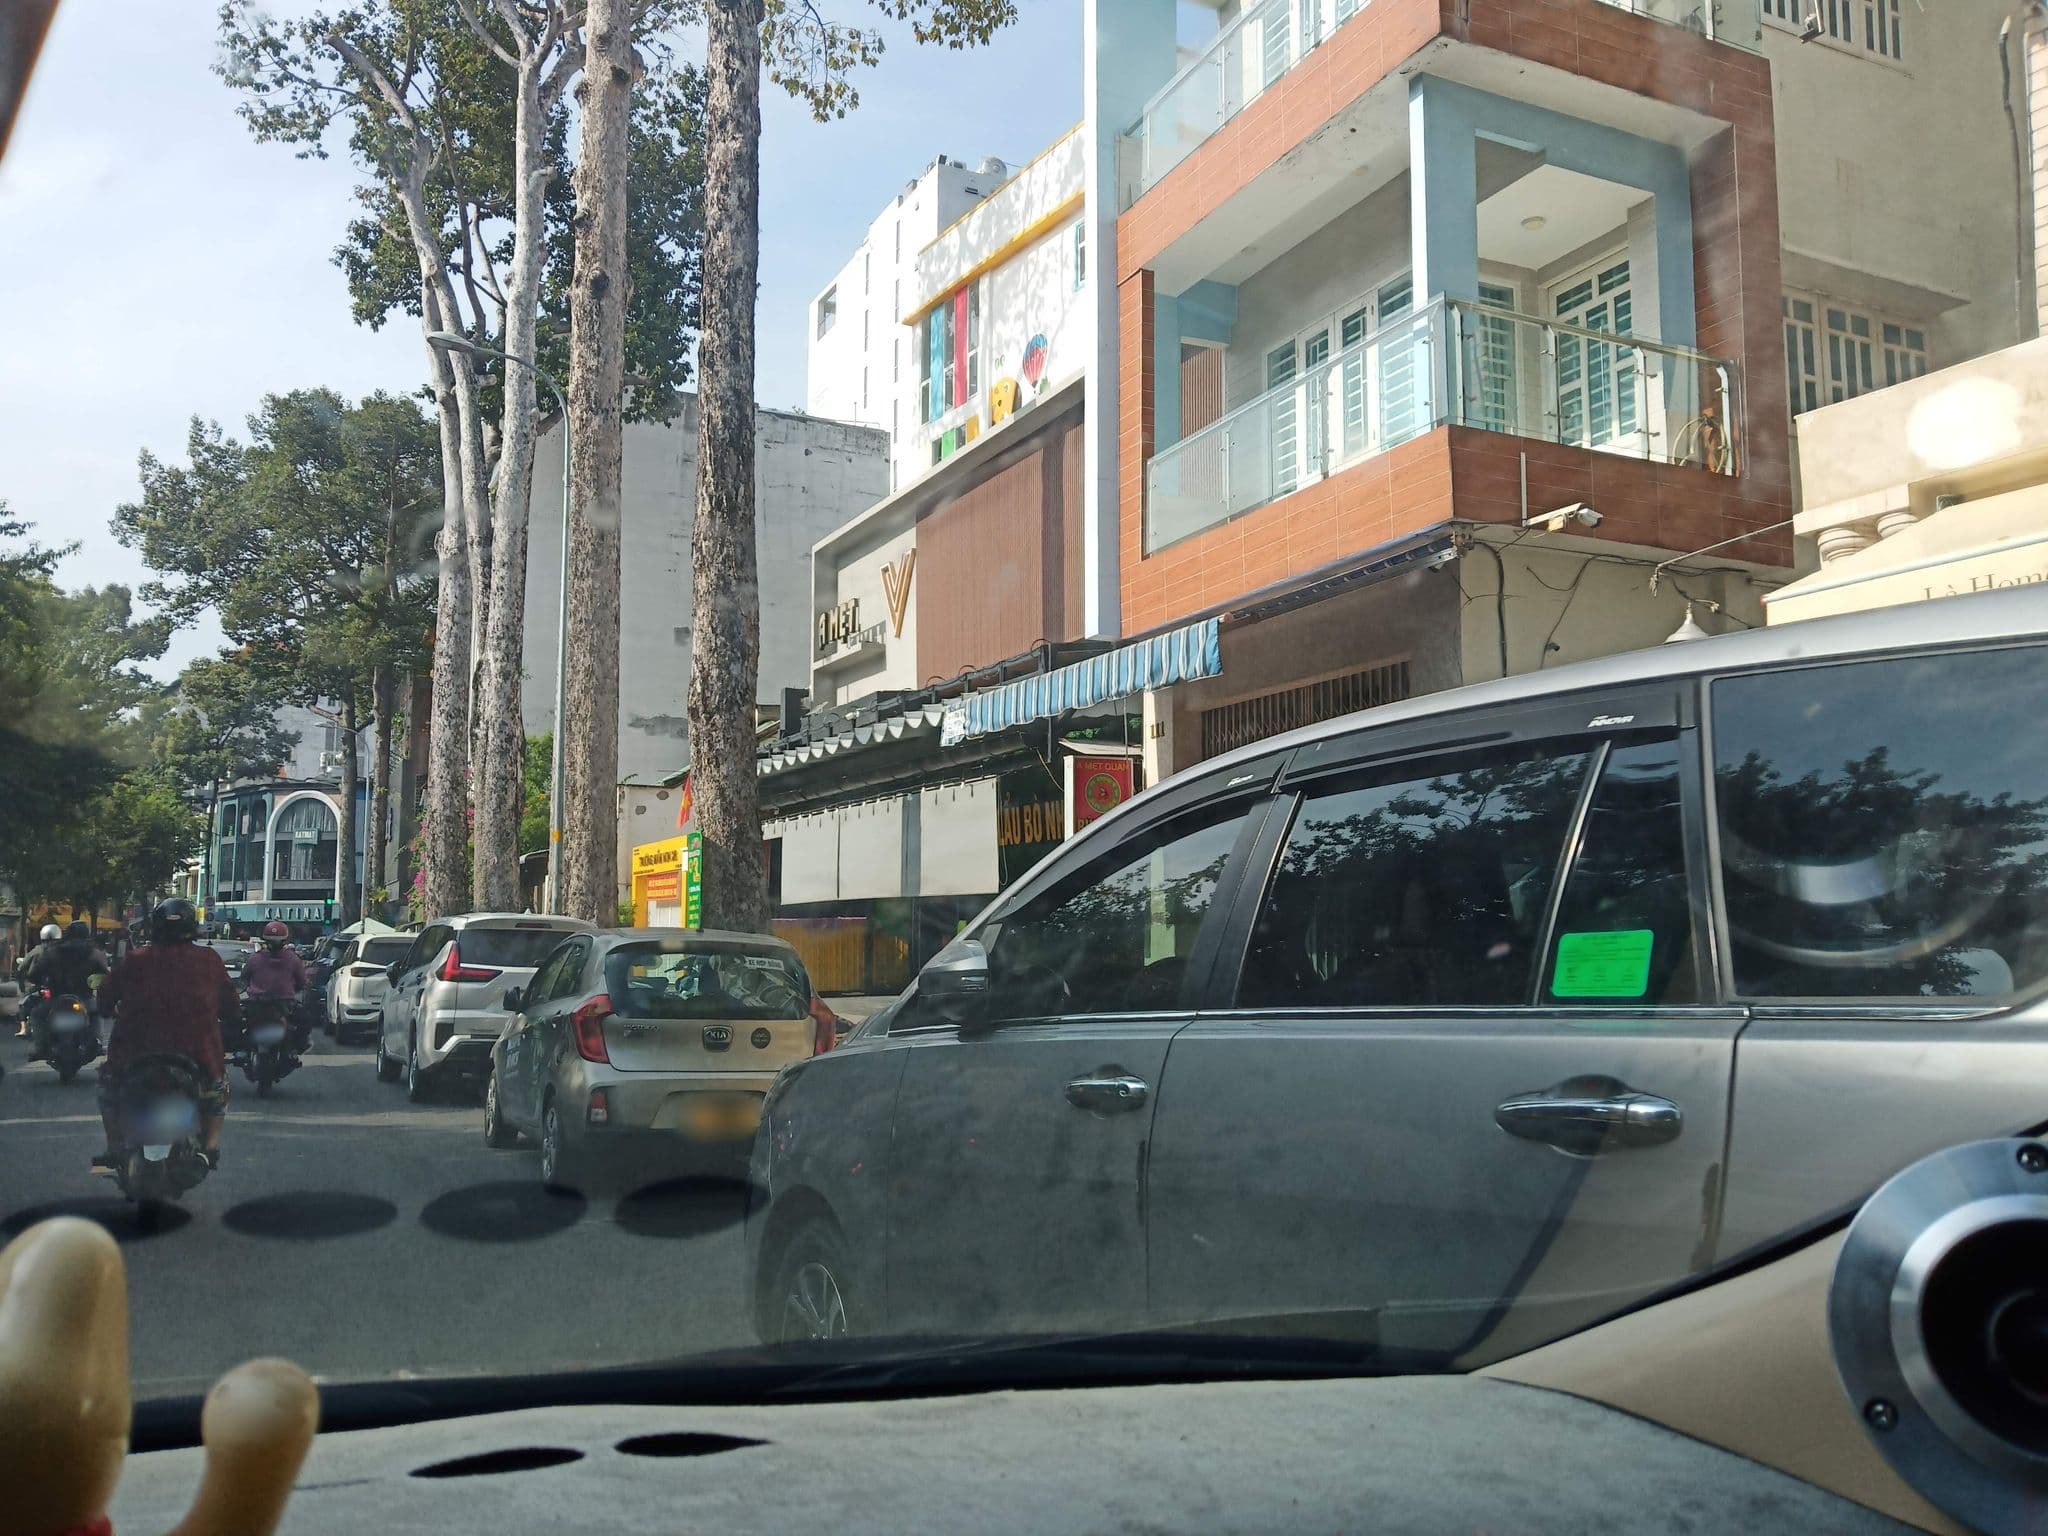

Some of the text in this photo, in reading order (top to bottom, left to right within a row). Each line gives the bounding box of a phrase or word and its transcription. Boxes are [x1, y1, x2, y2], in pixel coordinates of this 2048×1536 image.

[1023, 792, 1043, 844] BÒ
[264, 907, 321, 919] KATINA
[709, 1030, 728, 1039] KIA
